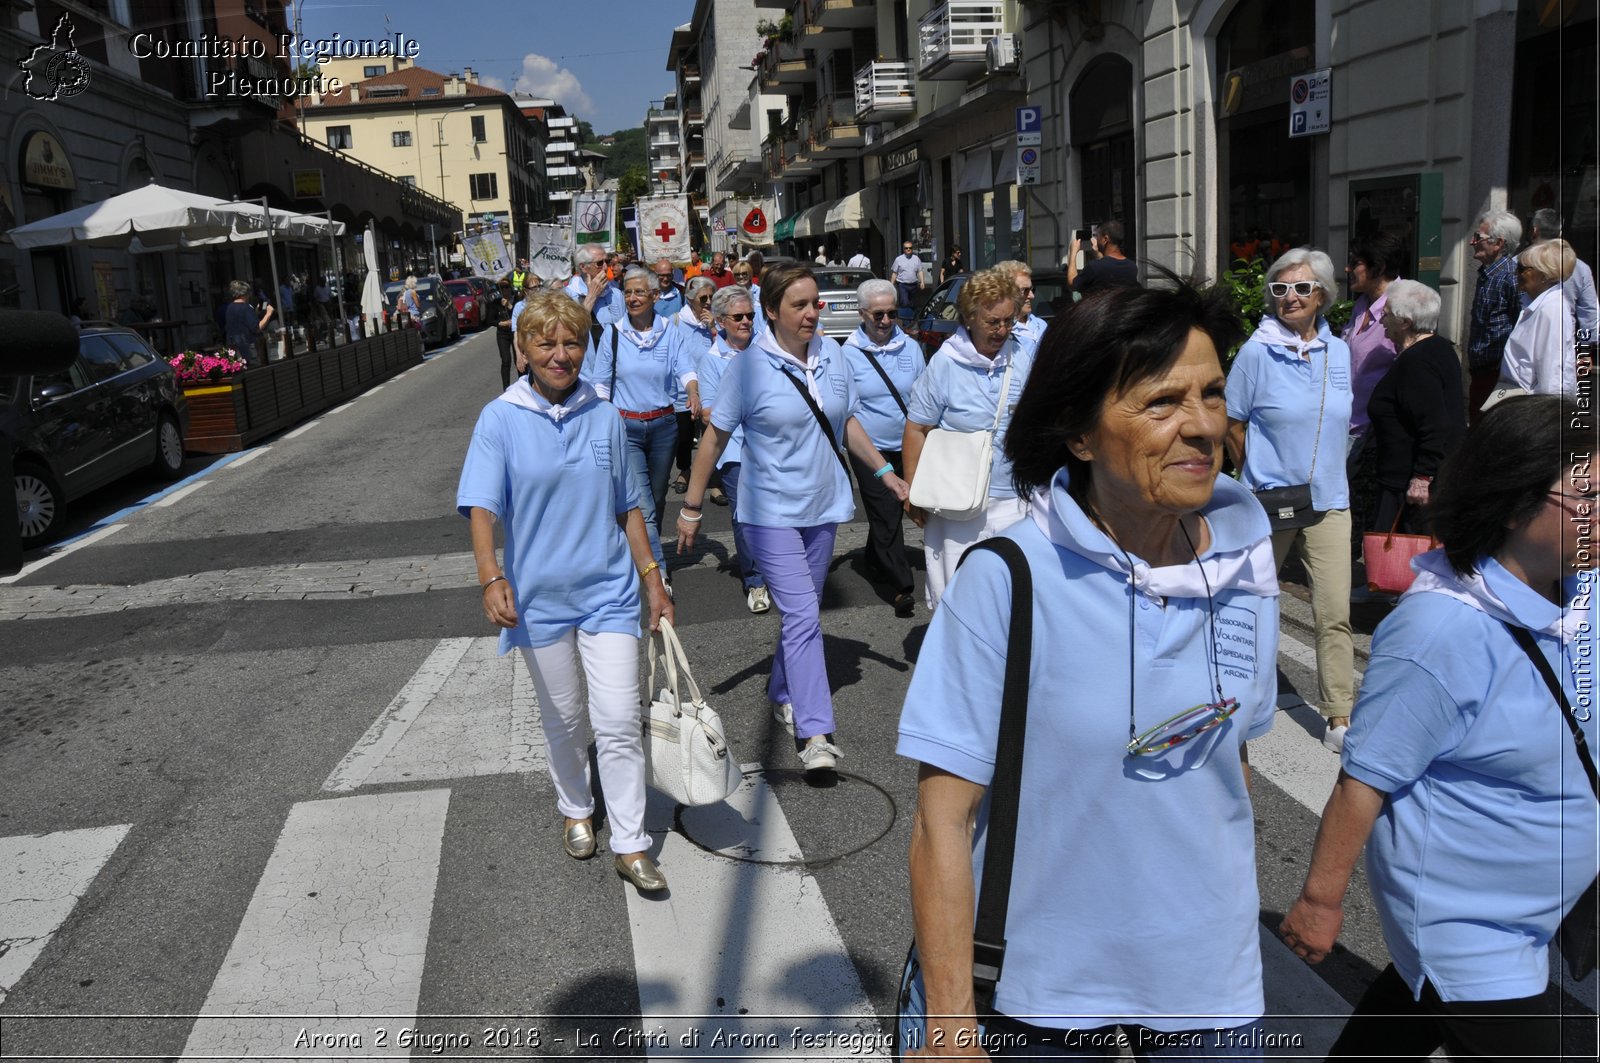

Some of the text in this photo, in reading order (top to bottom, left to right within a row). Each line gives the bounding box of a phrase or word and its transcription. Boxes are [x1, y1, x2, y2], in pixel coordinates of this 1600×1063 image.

[1020, 109, 1036, 131] P
[1295, 114, 1304, 132] P
[32, 162, 66, 178] JIMMY'S
[1224, 669, 1249, 680] ARONA
